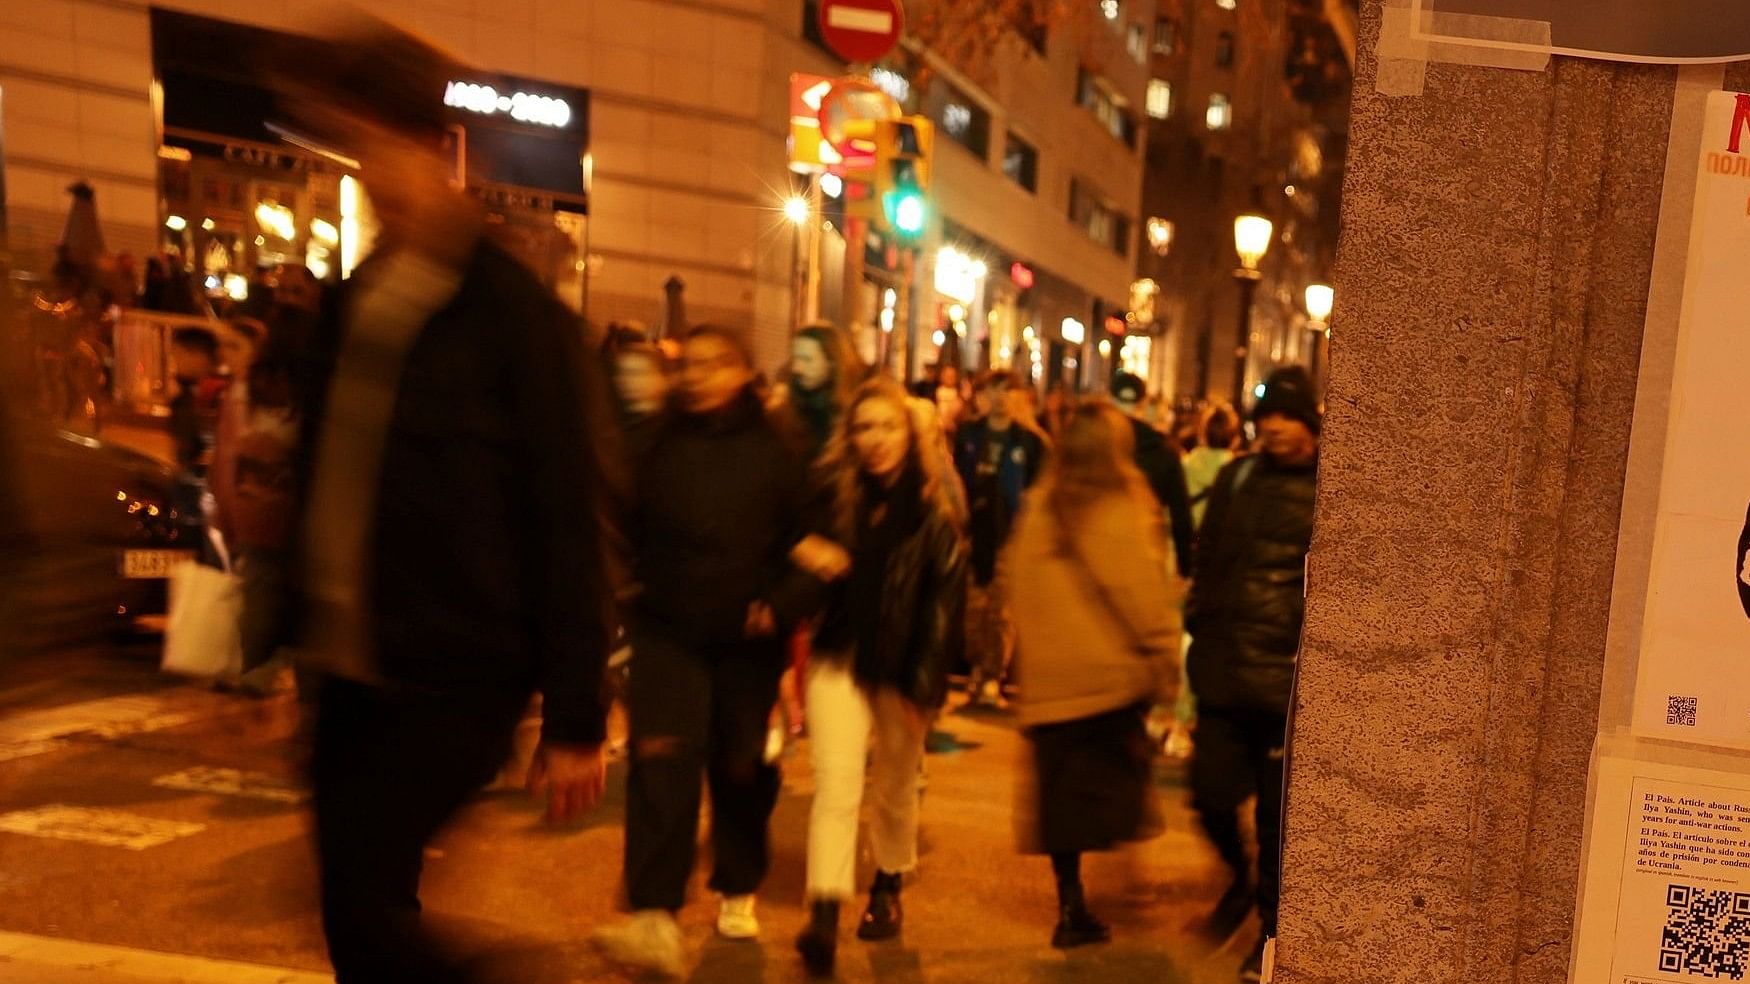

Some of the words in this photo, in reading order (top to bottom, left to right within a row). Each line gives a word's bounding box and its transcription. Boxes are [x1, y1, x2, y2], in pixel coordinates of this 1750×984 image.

[1645, 793, 1654, 801] El
[1678, 798, 1705, 808] Article
[1708, 801, 1730, 811] about
[1643, 803, 1659, 813] Ilya
[1664, 806, 1692, 817] Yashin,
[1697, 810, 1713, 819] who
[1642, 815, 1663, 823] years
[1665, 816, 1678, 824] for
[1678, 819, 1712, 829] anti-war
[1713, 823, 1743, 833] actions.
[1640, 838, 1657, 848] Iliya
[1660, 840, 1686, 850] Yashin
[1706, 846, 1716, 854] ha
[1718, 848, 1734, 856] sido
[1672, 831, 1682, 839] El
[1683, 834, 1714, 844] artículo
[1716, 838, 1737, 846] sobre
[1637, 858, 1647, 866] de
[1648, 859, 1682, 870] Ucrania.
[1638, 848, 1656, 857] años
[1660, 850, 1670, 858] de
[1672, 852, 1700, 862] prisión
[1703, 857, 1718, 865] por
